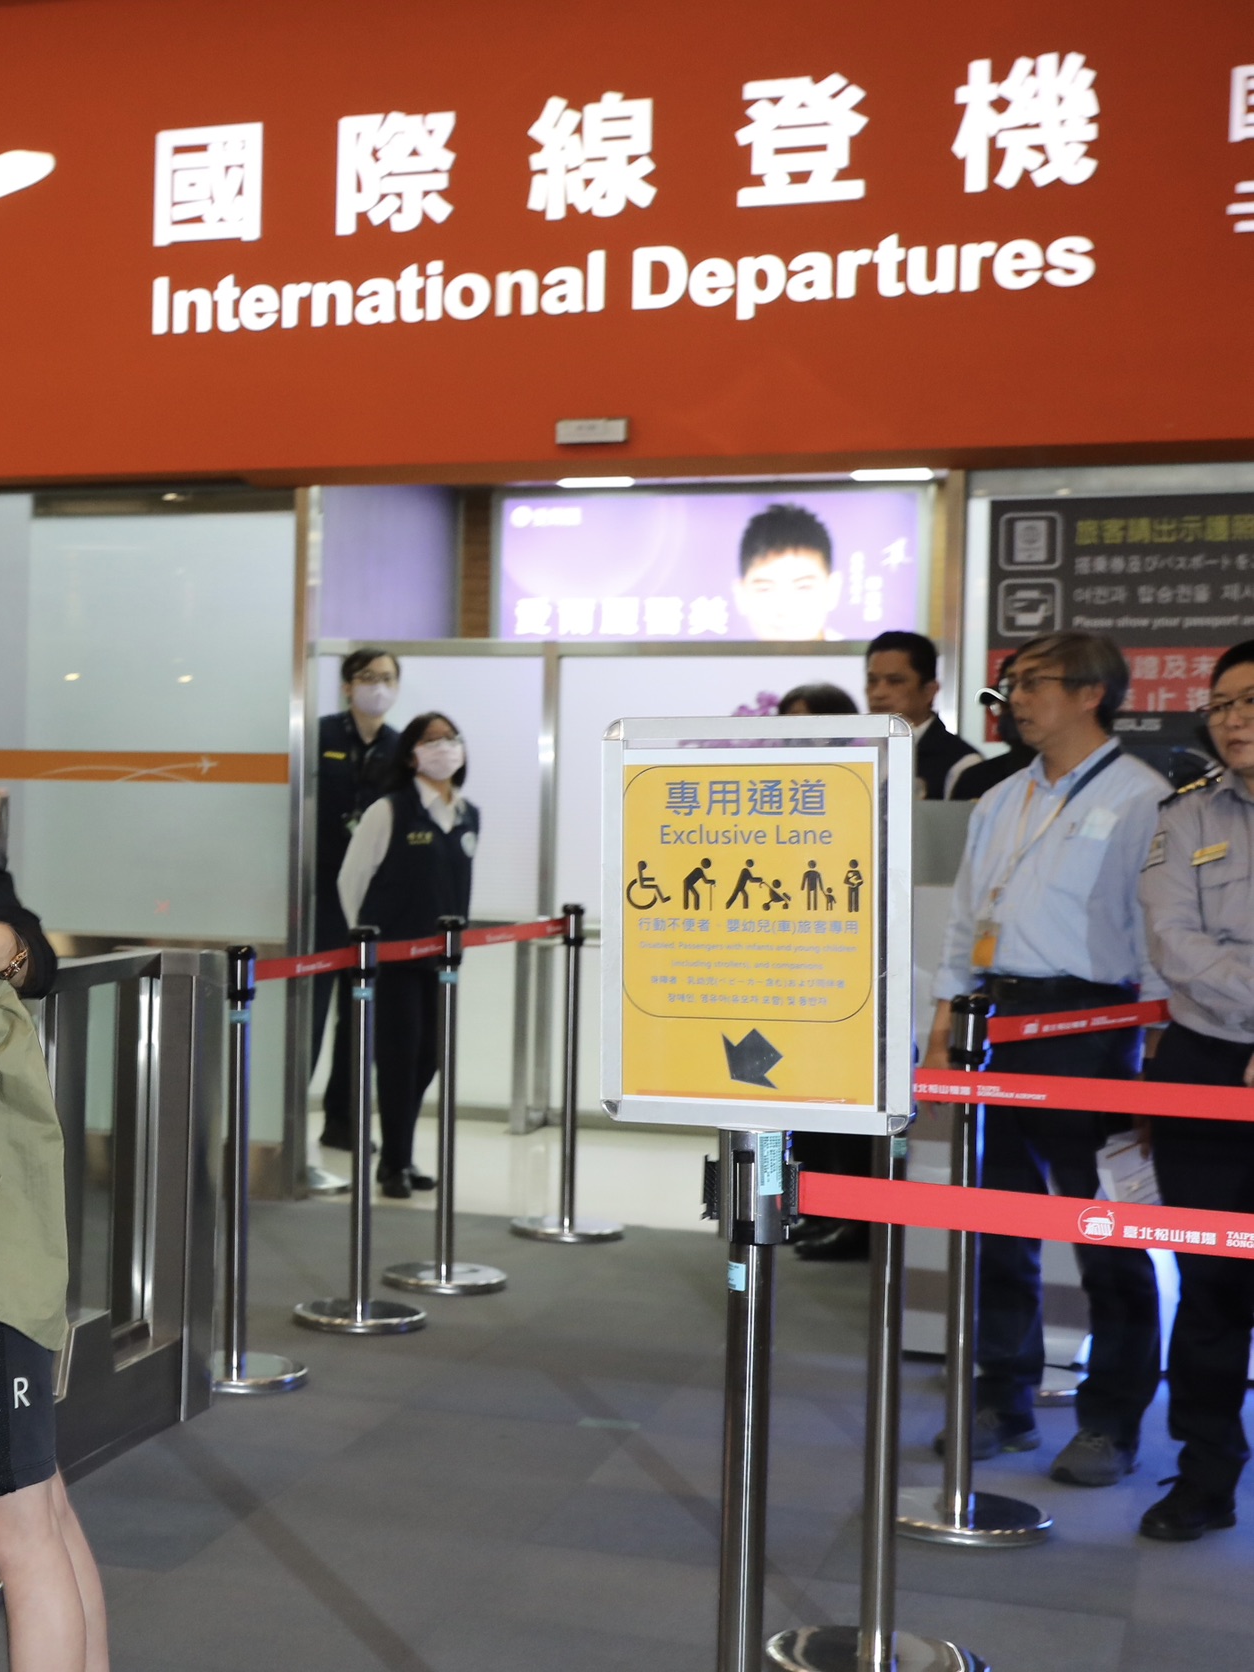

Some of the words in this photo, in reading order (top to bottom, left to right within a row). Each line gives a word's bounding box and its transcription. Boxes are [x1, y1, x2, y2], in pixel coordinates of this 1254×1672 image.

[154, 53, 1099, 246] 國際線登機
[152, 250, 606, 334] International
[632, 234, 1095, 320] Departures
[664, 778, 827, 817] 專用通道
[659, 824, 767, 845] Exclusive
[776, 824, 833, 845] Lane
[1123, 1225, 1217, 1245] 臺北松山機場
[1226, 1239, 1254, 1249] SONG
[13, 1377, 31, 1409] R
